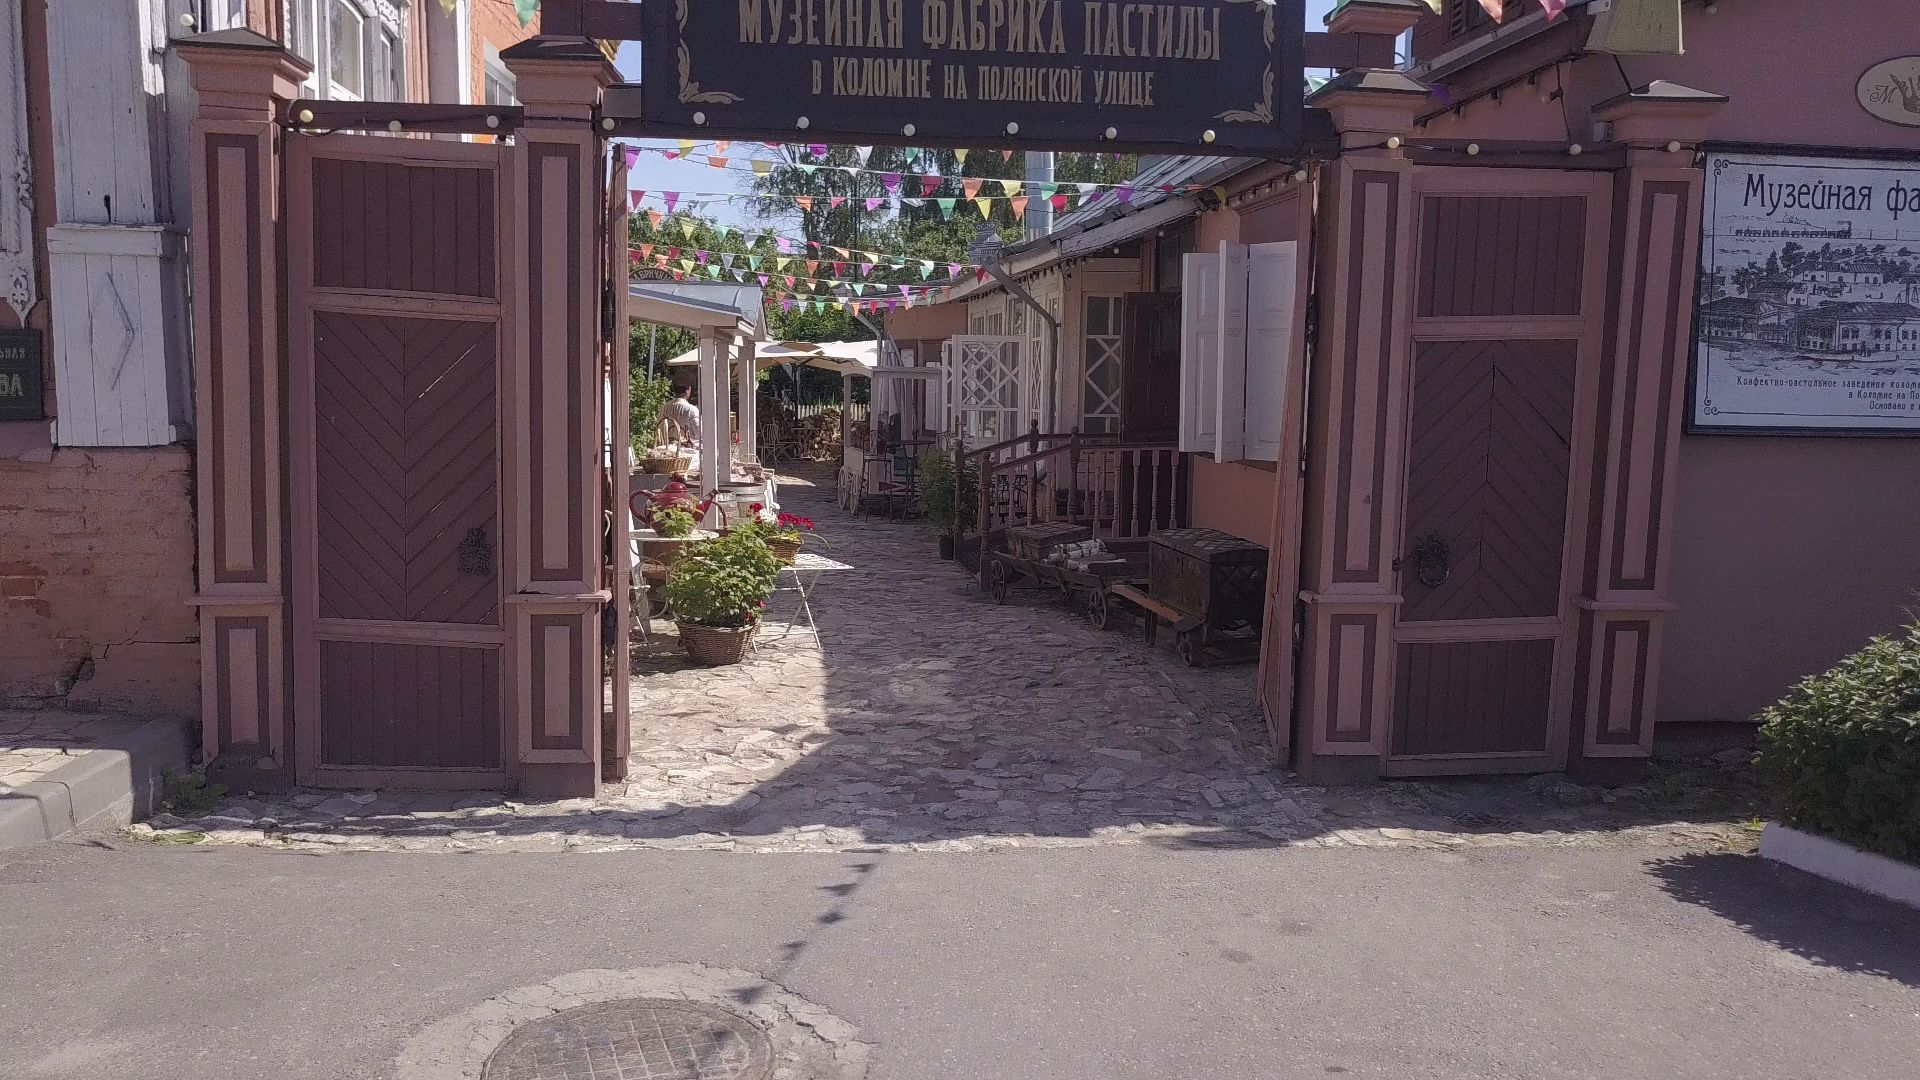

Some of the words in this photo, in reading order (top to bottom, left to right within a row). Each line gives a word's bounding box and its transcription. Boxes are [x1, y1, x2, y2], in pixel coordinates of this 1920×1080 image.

[922, 0, 1066, 53] ФАБРИКА
[1083, 1, 1221, 60] ПАСТИЛЫ
[811, 59, 823, 95] В
[832, 56, 932, 98] КОЛОМНЕ
[943, 64, 968, 100] НА
[977, 65, 1082, 104] ПОЛЯНСКОЙ
[1093, 69, 1155, 108] УЛИЦЕ
[1743, 172, 1873, 217] Музейная
[1886, 178, 1920, 220] фа
[1841, 380, 1885, 389] заведение
[1857, 389, 1893, 400] Коломне
[1896, 391, 1906, 400] на
[1869, 400, 1906, 410] Основано
